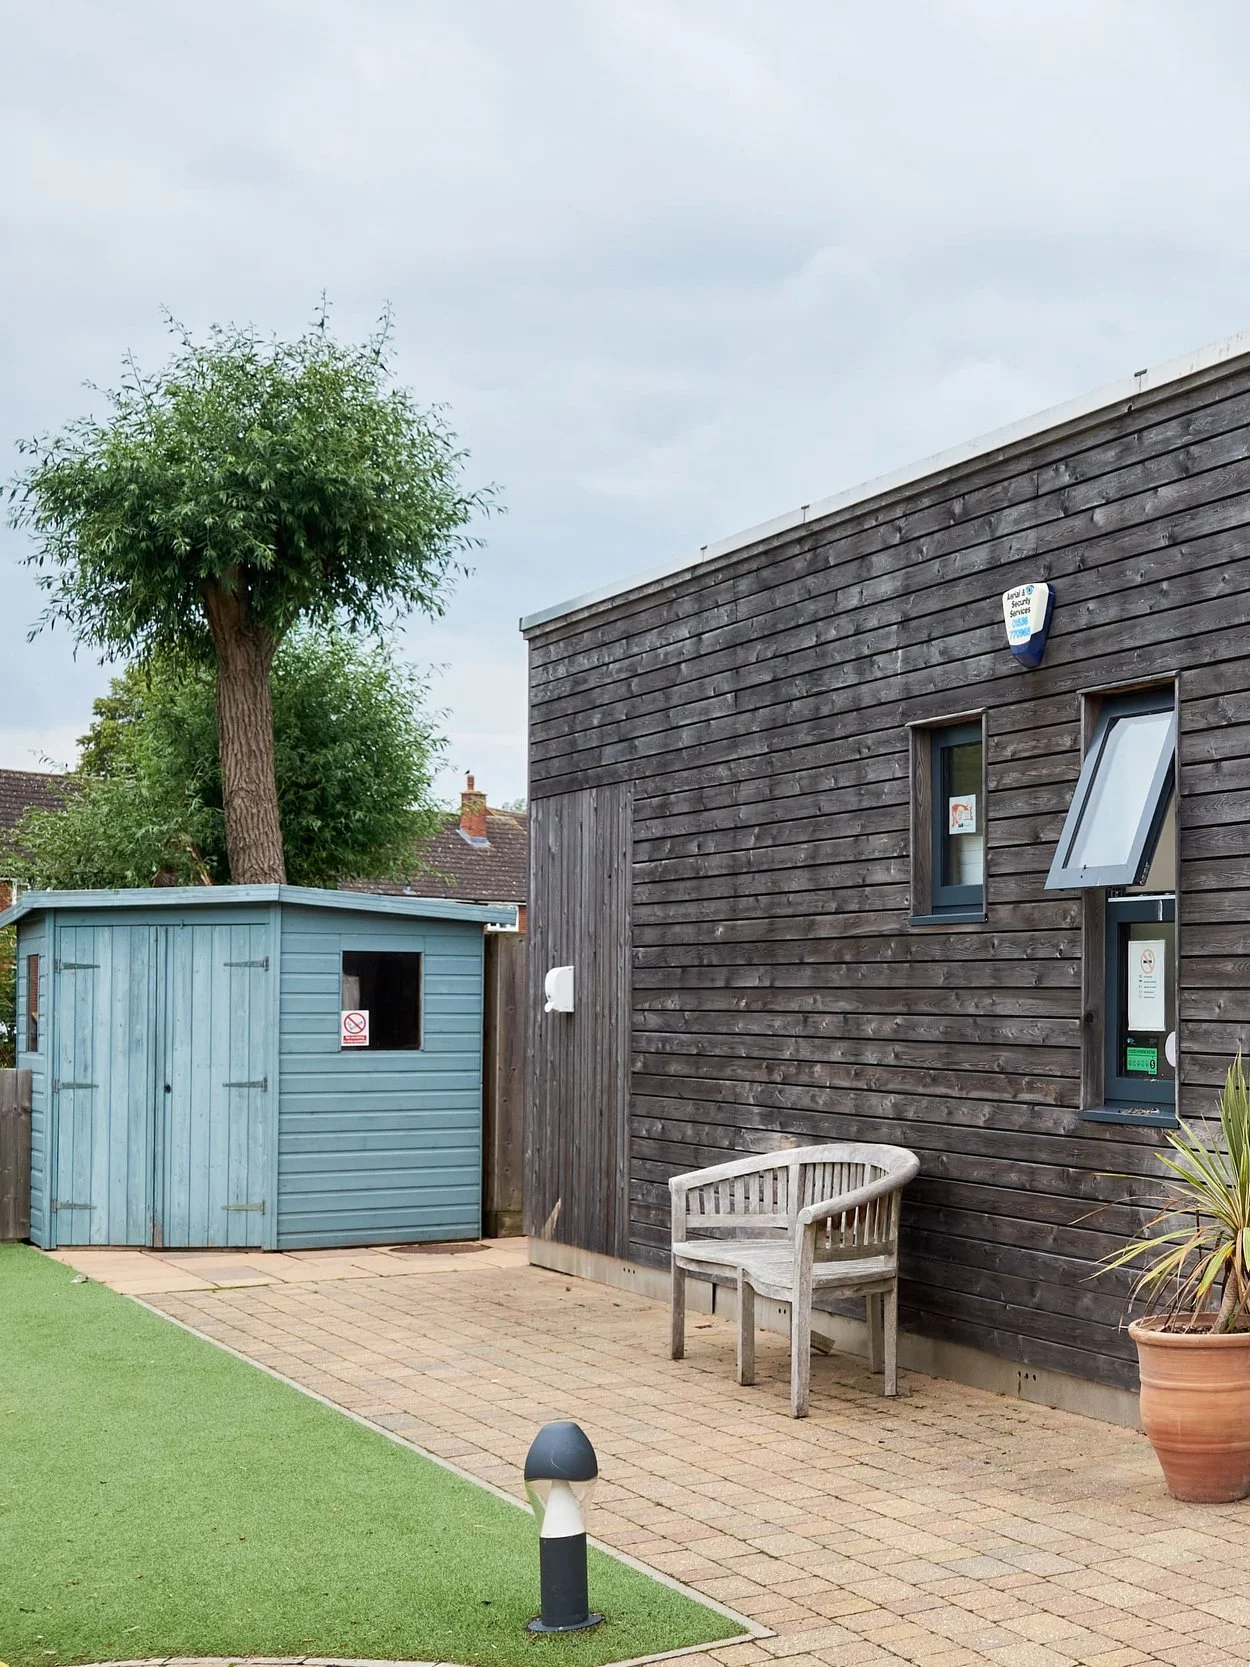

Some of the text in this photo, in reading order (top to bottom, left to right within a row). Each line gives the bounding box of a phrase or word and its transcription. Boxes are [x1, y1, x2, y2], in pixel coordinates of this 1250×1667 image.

[1007, 589, 1021, 600] Aerial
[1011, 597, 1031, 608] Security
[1009, 606, 1031, 618] Services
